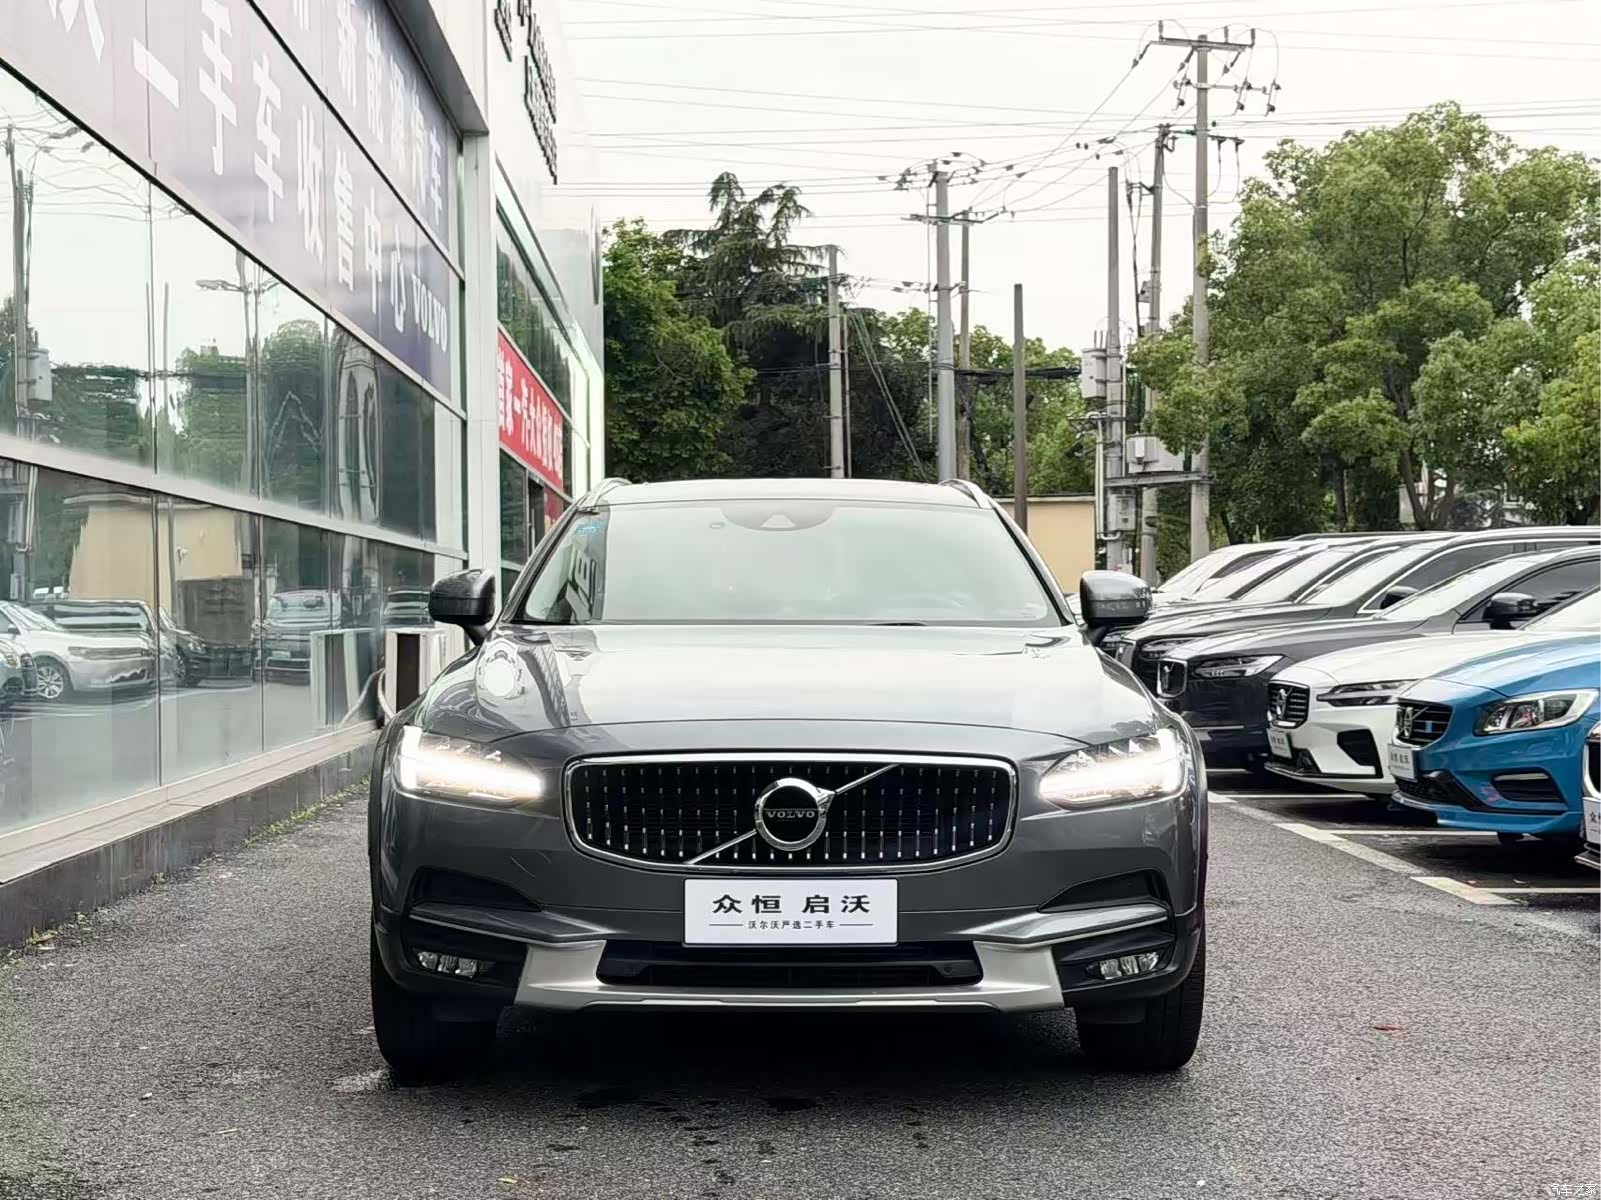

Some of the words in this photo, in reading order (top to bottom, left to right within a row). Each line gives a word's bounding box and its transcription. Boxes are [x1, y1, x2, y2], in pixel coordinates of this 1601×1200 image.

[411, 272, 448, 353] VOLVO
[765, 810, 816, 819] VOLVO
[712, 894, 782, 914] 众恒
[801, 894, 871, 914] 启沃
[748, 920, 836, 930] 沃尔沃严选二手车
